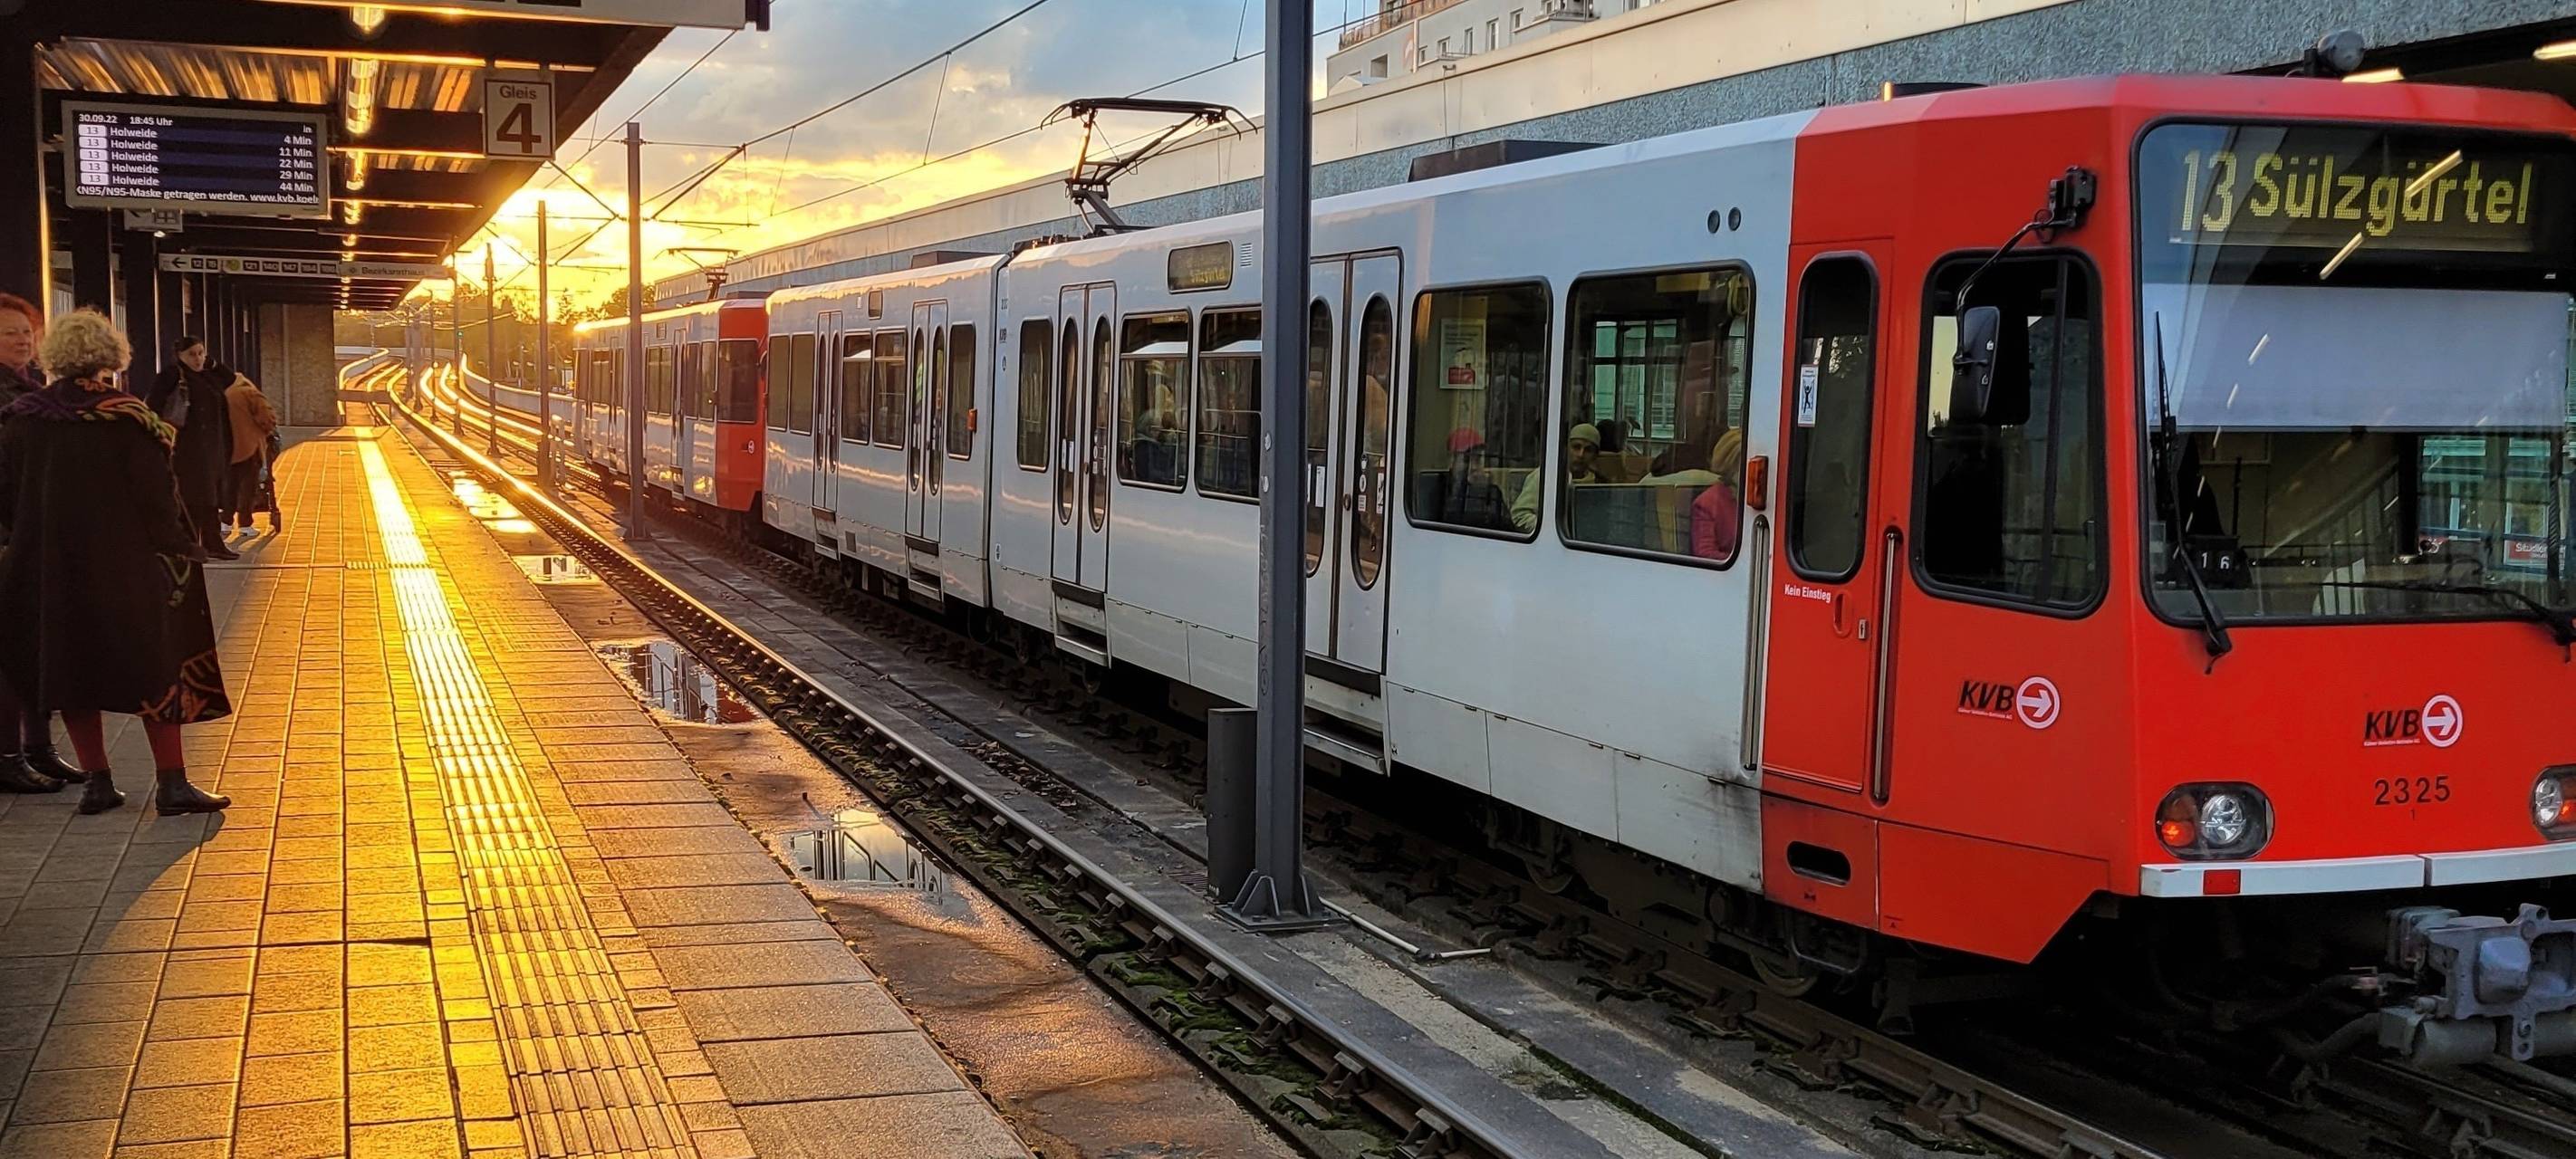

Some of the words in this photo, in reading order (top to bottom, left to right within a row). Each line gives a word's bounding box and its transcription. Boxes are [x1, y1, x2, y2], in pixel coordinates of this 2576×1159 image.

[500, 85, 537, 100] Gleis
[79, 113, 118, 123] 30.09.22
[130, 116, 155, 125] 18:45
[156, 117, 173, 126] Uhr
[303, 125, 312, 133] in
[496, 103, 542, 153] 4
[111, 127, 158, 138] Holweide
[284, 135, 291, 144] 4
[293, 136, 312, 145] Min
[111, 139, 159, 150] Holweide
[279, 147, 292, 157] 11
[293, 148, 313, 157] Min
[111, 151, 159, 162] Holweide
[279, 158, 292, 168] 22
[293, 159, 313, 168] Min
[112, 163, 159, 174] Holweide
[280, 170, 292, 179] 29
[293, 171, 313, 180] Min
[112, 176, 160, 186] Holweide
[279, 182, 293, 191] 44
[294, 182, 314, 192] Min
[2181, 150, 2237, 232] 13
[2249, 151, 2533, 237] Sülzgürtel
[164, 189, 207, 200] getragen
[208, 191, 249, 201] werden.
[1784, 583, 1801, 597] Kein
[1802, 587, 1831, 603] Einstieg
[1959, 680, 2014, 711] KVB
[2365, 709, 2420, 739] KVB
[2375, 776, 2450, 805] 2325
